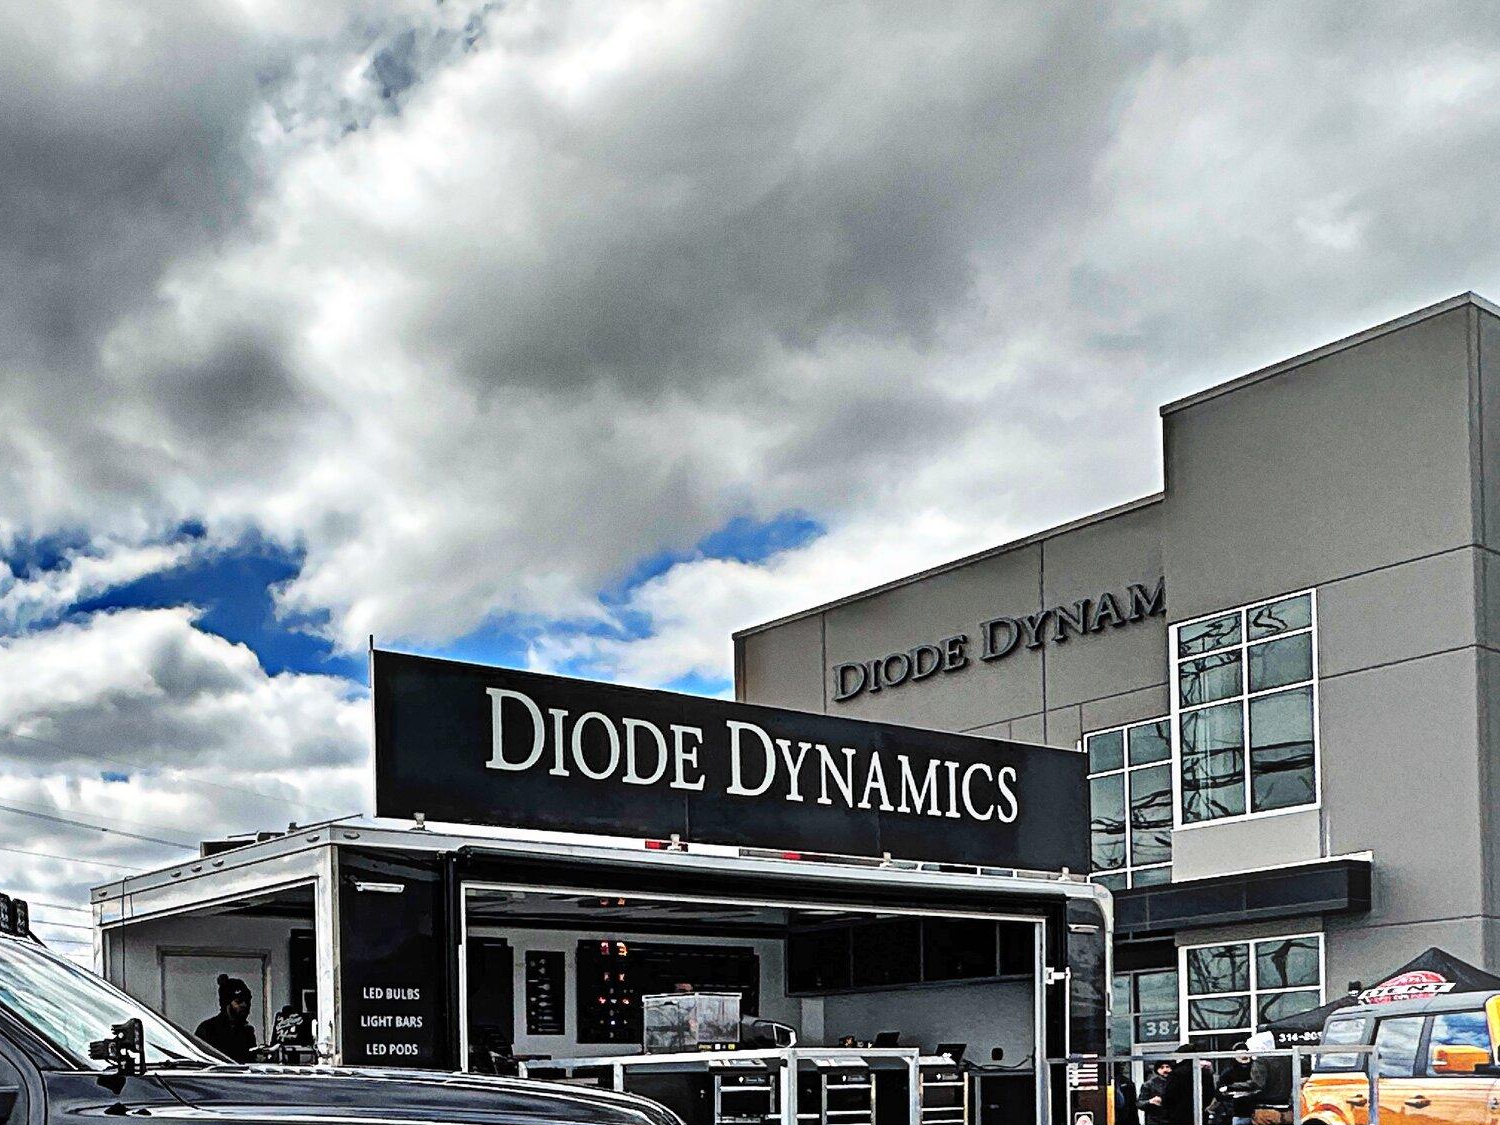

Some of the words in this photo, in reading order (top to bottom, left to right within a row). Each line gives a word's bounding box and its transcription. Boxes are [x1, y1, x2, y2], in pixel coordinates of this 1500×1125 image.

[832, 634, 970, 702] DIODE
[980, 577, 1167, 662] DYNAM
[485, 687, 706, 791] DIODE
[726, 720, 1019, 823] DYNAMICS
[362, 986, 384, 999] LED
[385, 987, 420, 1000] BULBS
[361, 1015, 393, 1028] LIGHT
[395, 1015, 423, 1028] BARS
[366, 1043, 387, 1055] LED
[389, 1043, 418, 1056] PODS
